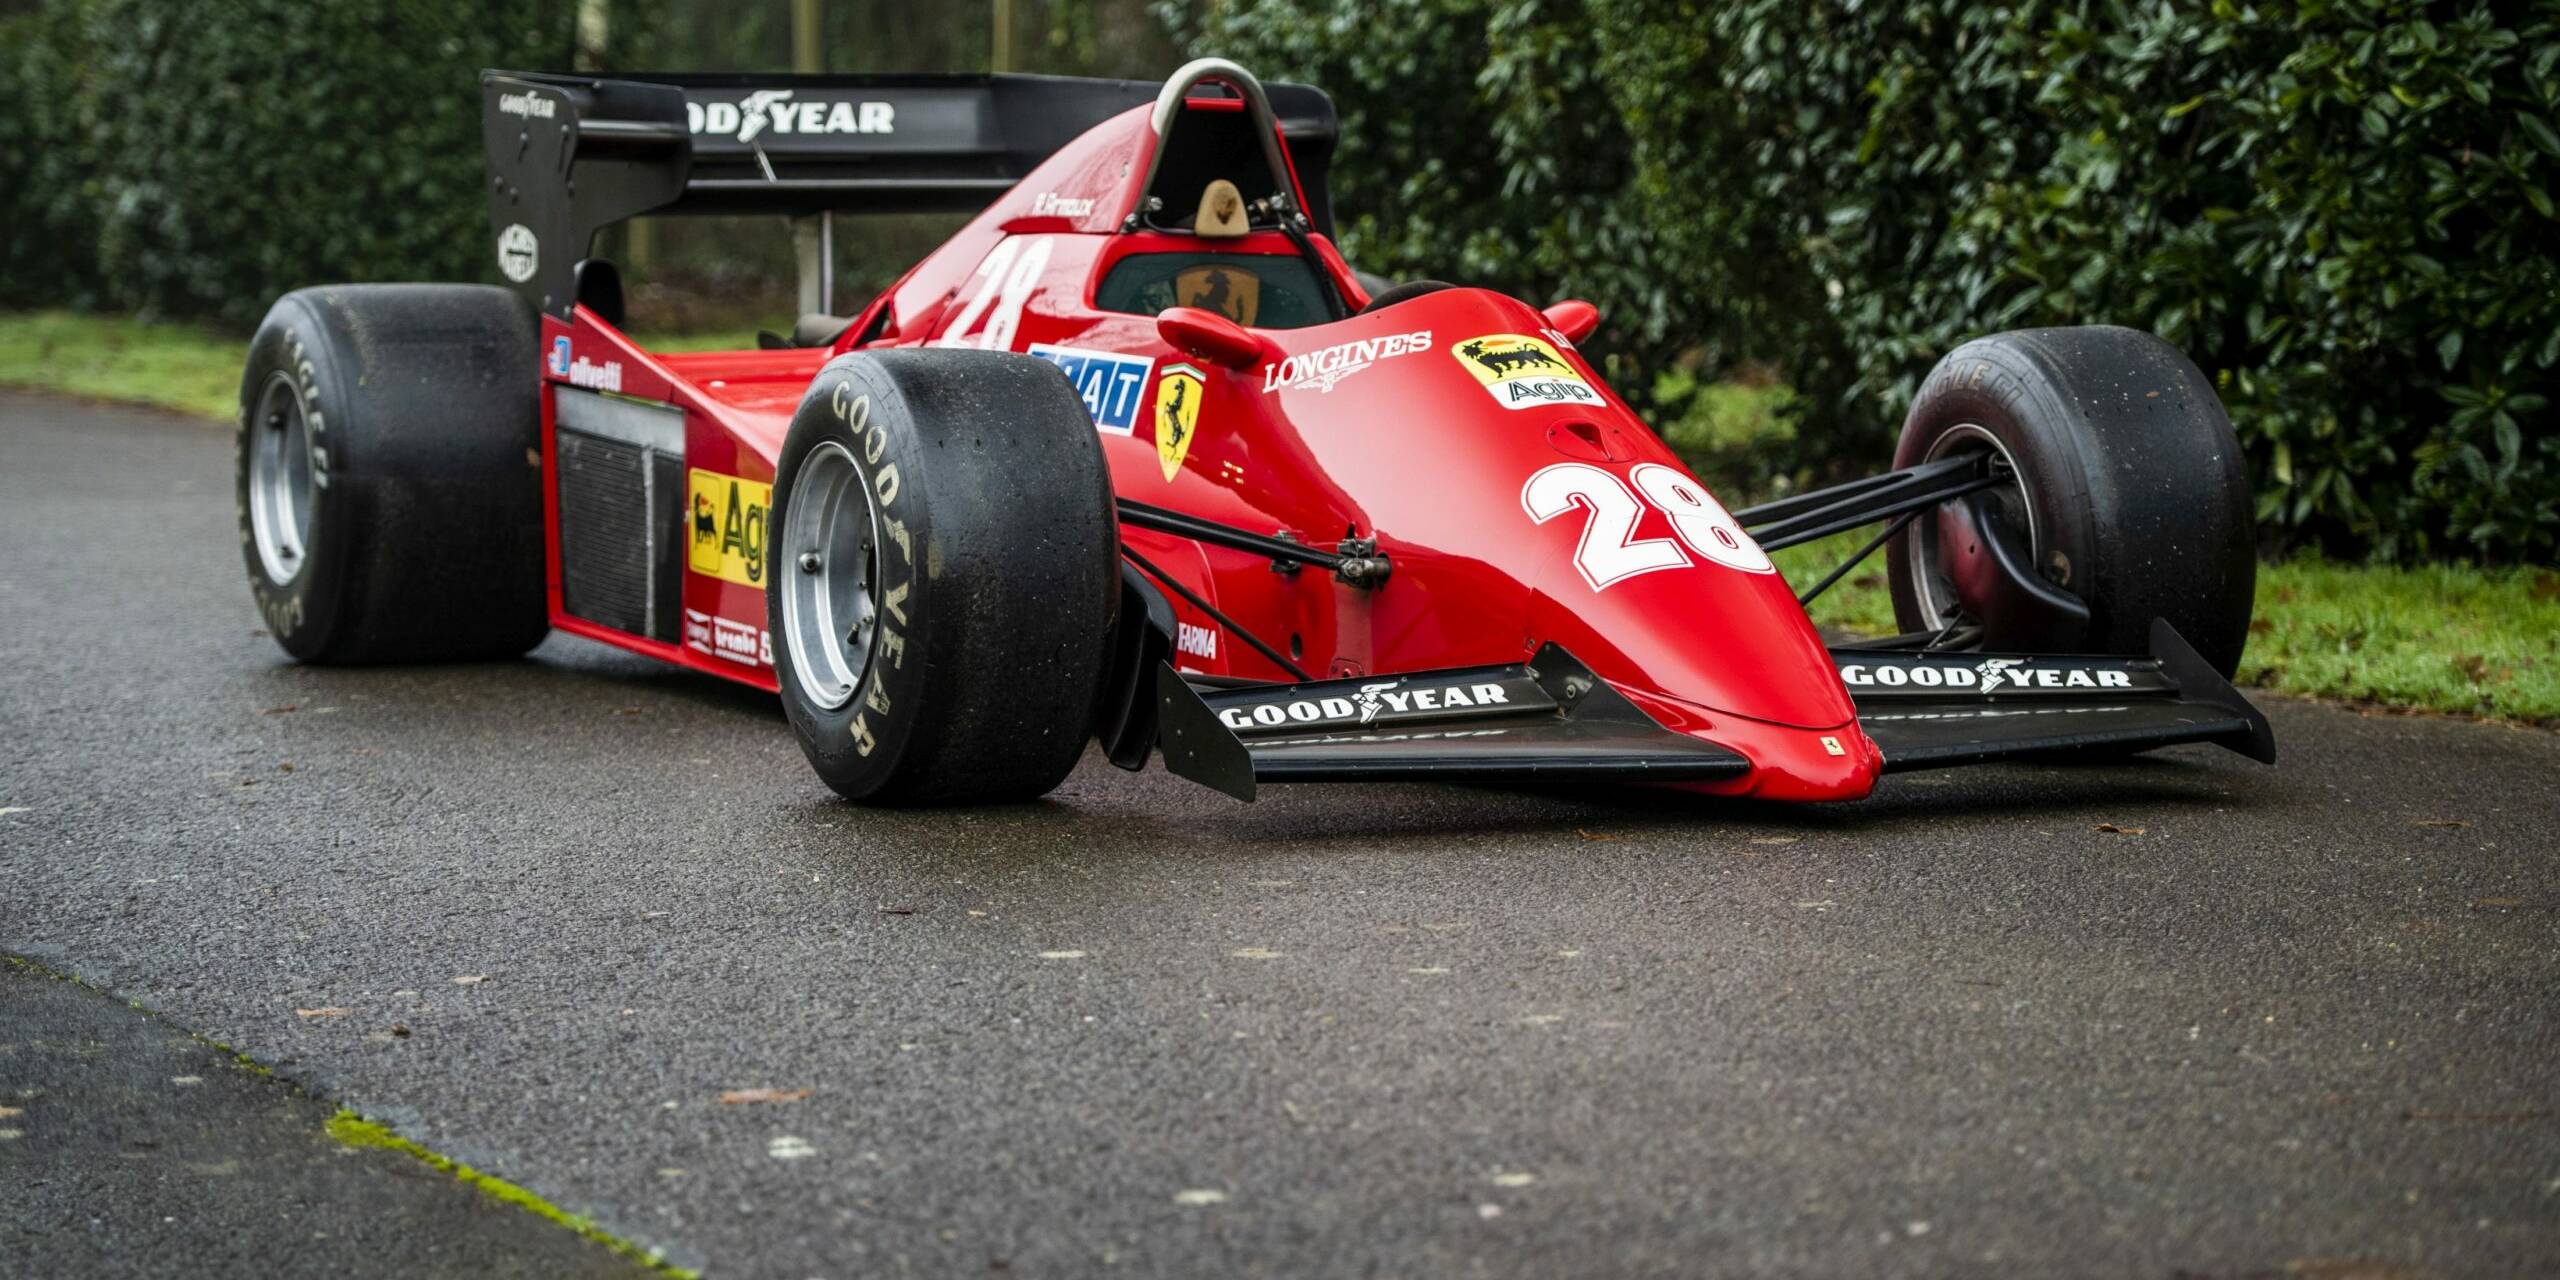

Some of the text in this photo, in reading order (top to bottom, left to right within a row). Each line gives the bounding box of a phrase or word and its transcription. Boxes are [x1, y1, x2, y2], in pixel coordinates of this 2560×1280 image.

[768, 102, 895, 134] YEAR
[938, 234, 1054, 351] 28
[1262, 330, 1433, 394] LONGINES
[1064, 366, 1140, 418] AT
[1509, 378, 1592, 401] Agip
[1521, 463, 1777, 593] 28
[832, 380, 907, 757] GOOD YEAR
[1177, 622, 1217, 660] FARINA
[1841, 665, 2132, 687] GOOD YEAR
[1219, 683, 1509, 729] GOOD YEAR
